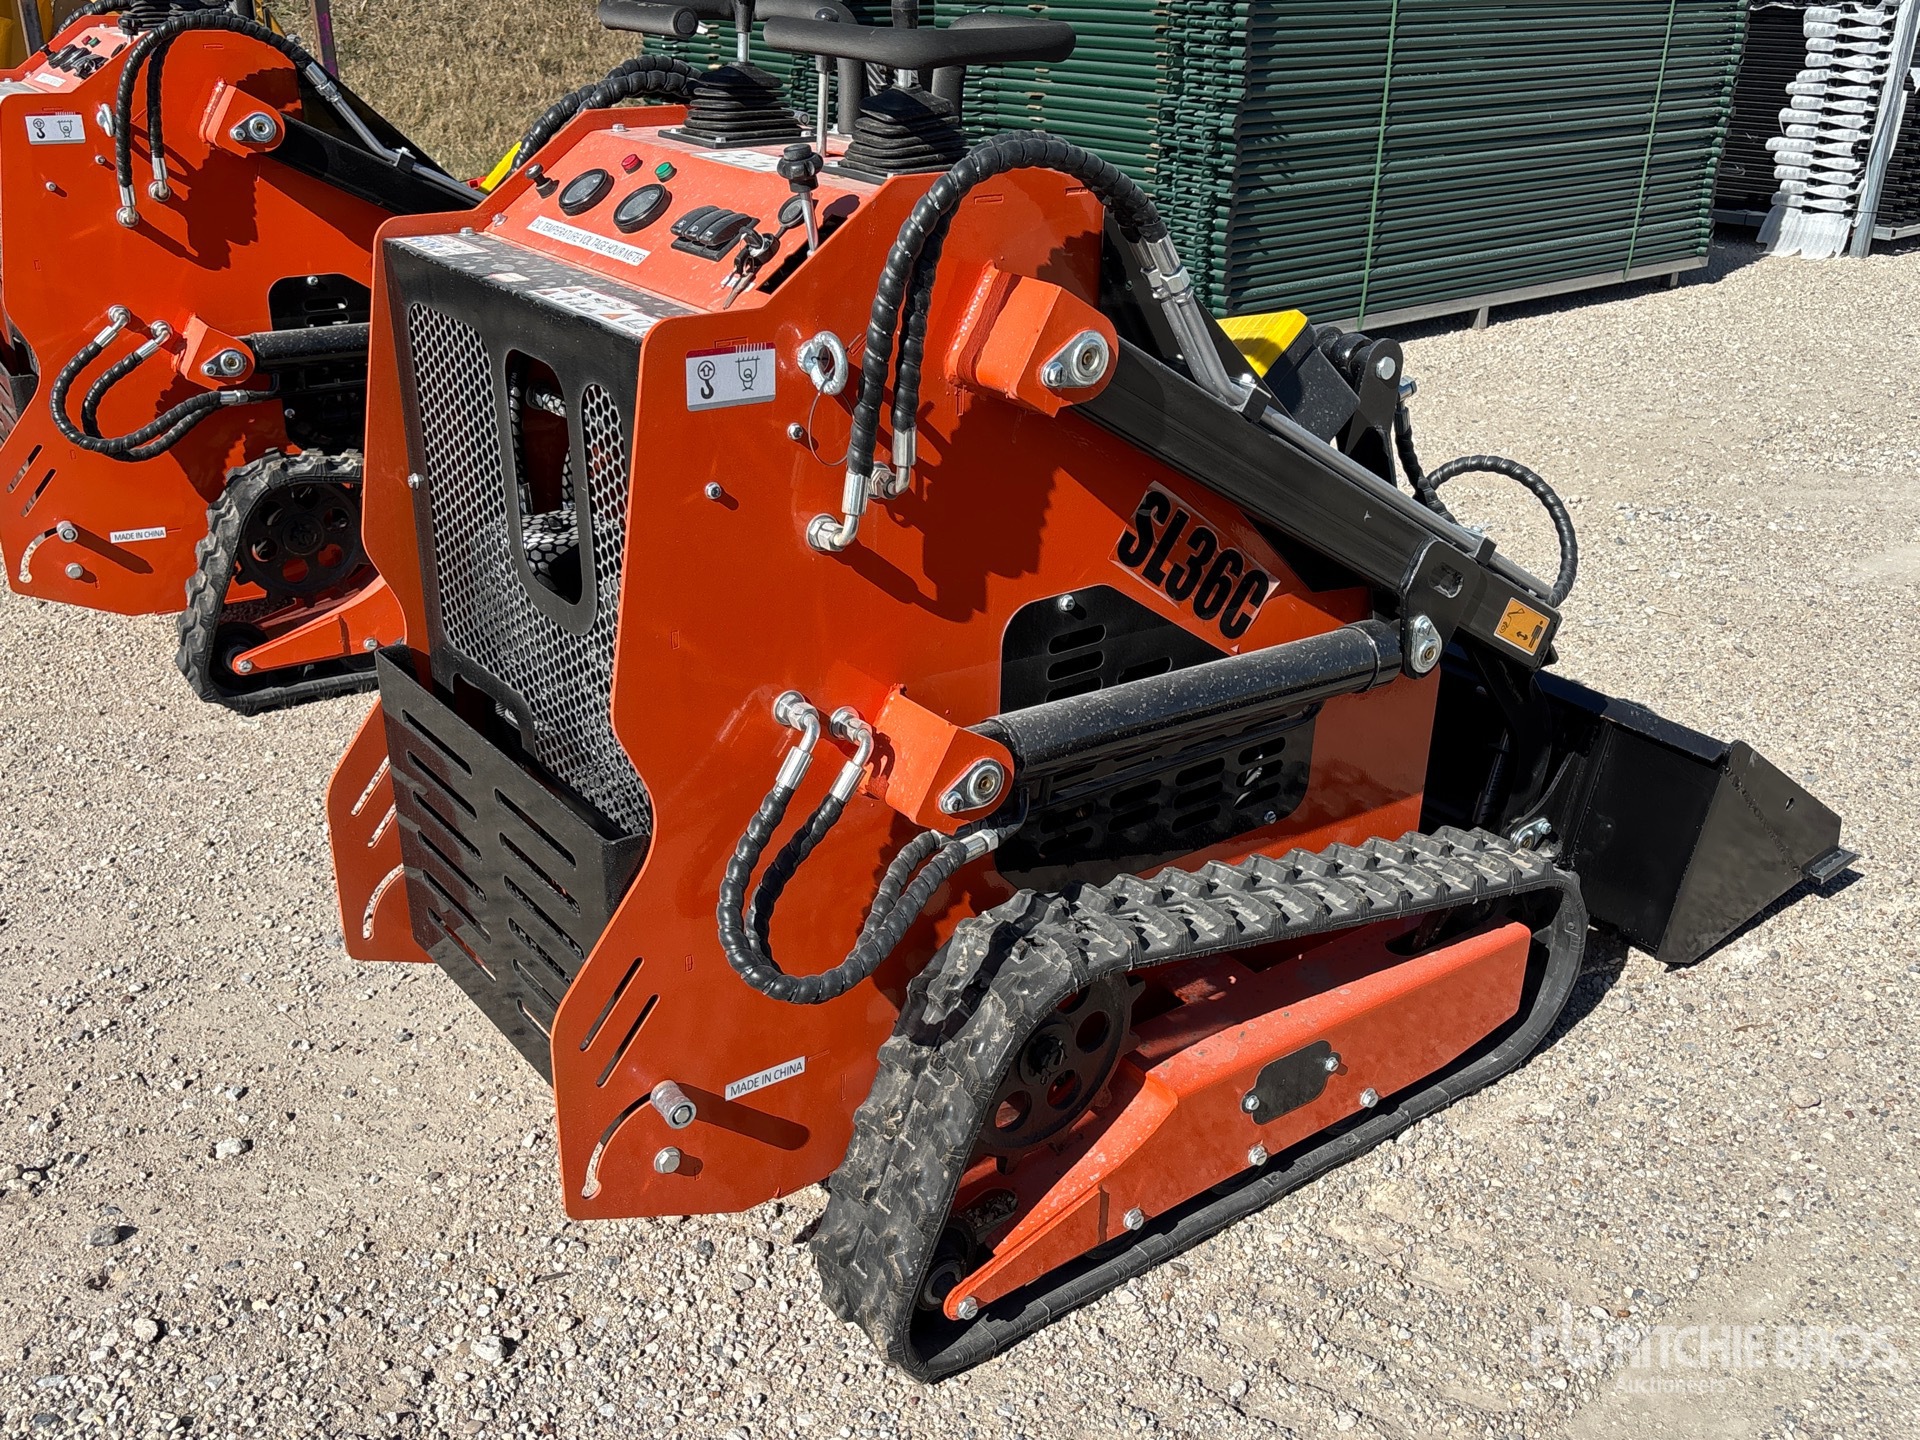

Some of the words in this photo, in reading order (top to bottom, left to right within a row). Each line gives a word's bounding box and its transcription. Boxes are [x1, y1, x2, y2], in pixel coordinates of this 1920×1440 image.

[541, 222, 582, 244] TEMPERATURE
[579, 235, 610, 252] VOLTAGE
[114, 533, 135, 541] MADE
[136, 531, 143, 539] IN
[144, 529, 165, 538] CHINA
[1116, 491, 1269, 640] SL36C
[730, 1077, 760, 1096] MADE
[761, 1074, 772, 1084] IN
[773, 1062, 803, 1080] CHINA
